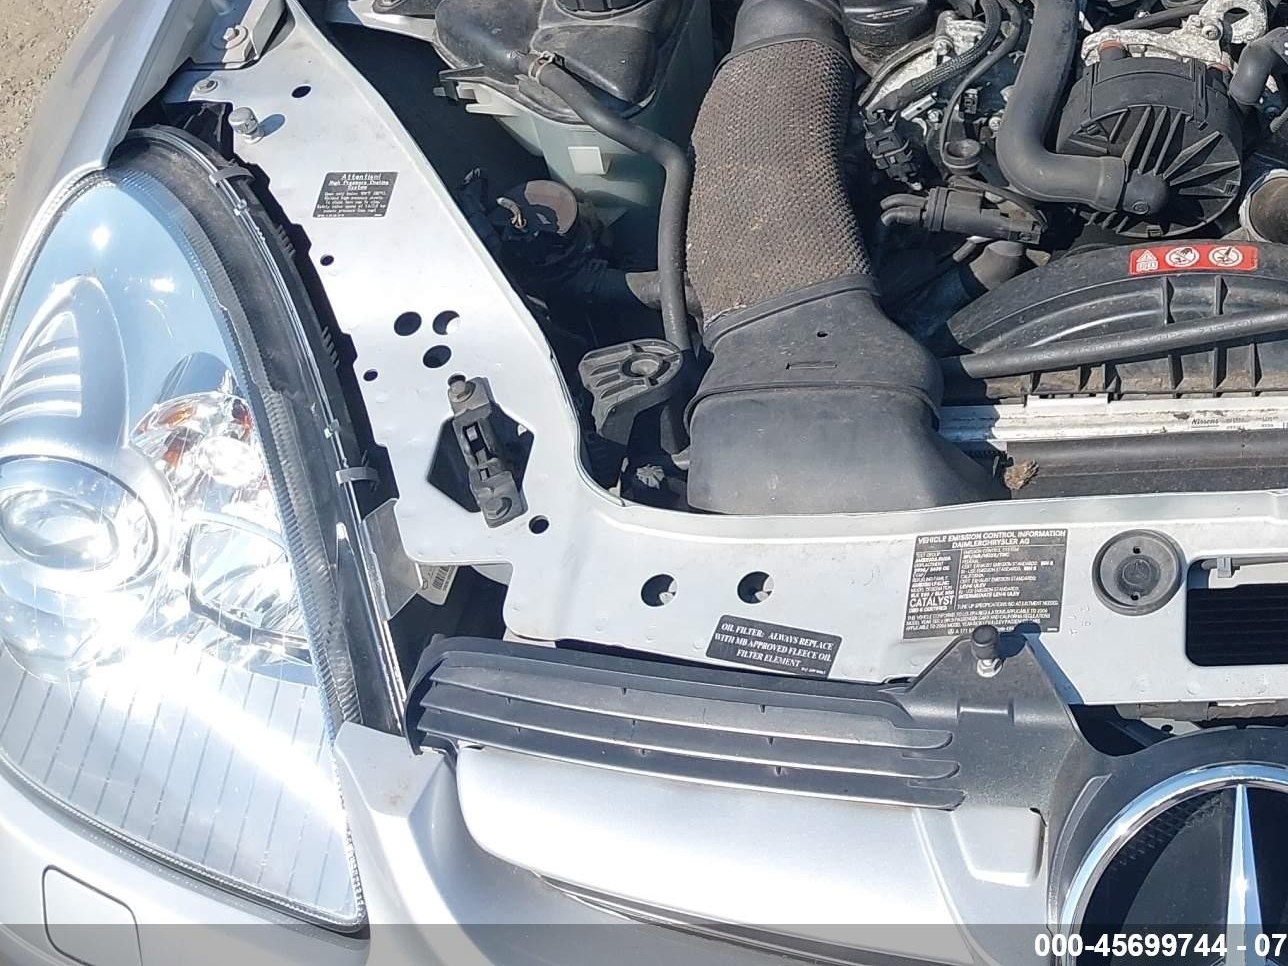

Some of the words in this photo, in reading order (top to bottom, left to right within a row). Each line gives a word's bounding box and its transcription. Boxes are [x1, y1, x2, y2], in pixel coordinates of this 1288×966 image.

[918, 535, 947, 544] VEHICLE
[948, 533, 981, 542] EMISSION
[983, 532, 1016, 540] CONTROL
[1018, 530, 1066, 538] INFORMATION
[952, 538, 1017, 548] DAIMLERCHRYSLER
[910, 594, 954, 608] CATALYST
[722, 623, 734, 632] OIL
[736, 626, 765, 637] FILTER:
[768, 632, 798, 644] ALWAYS
[799, 637, 834, 650] REPLACE
[715, 633, 735, 643] WITH
[735, 636, 748, 645] MB
[748, 639, 788, 653] APPROVED
[788, 646, 818, 658] FLEECE
[818, 653, 832, 662] OIL
[736, 649, 764, 660] FILTER
[764, 654, 801, 667] ELEMENT
